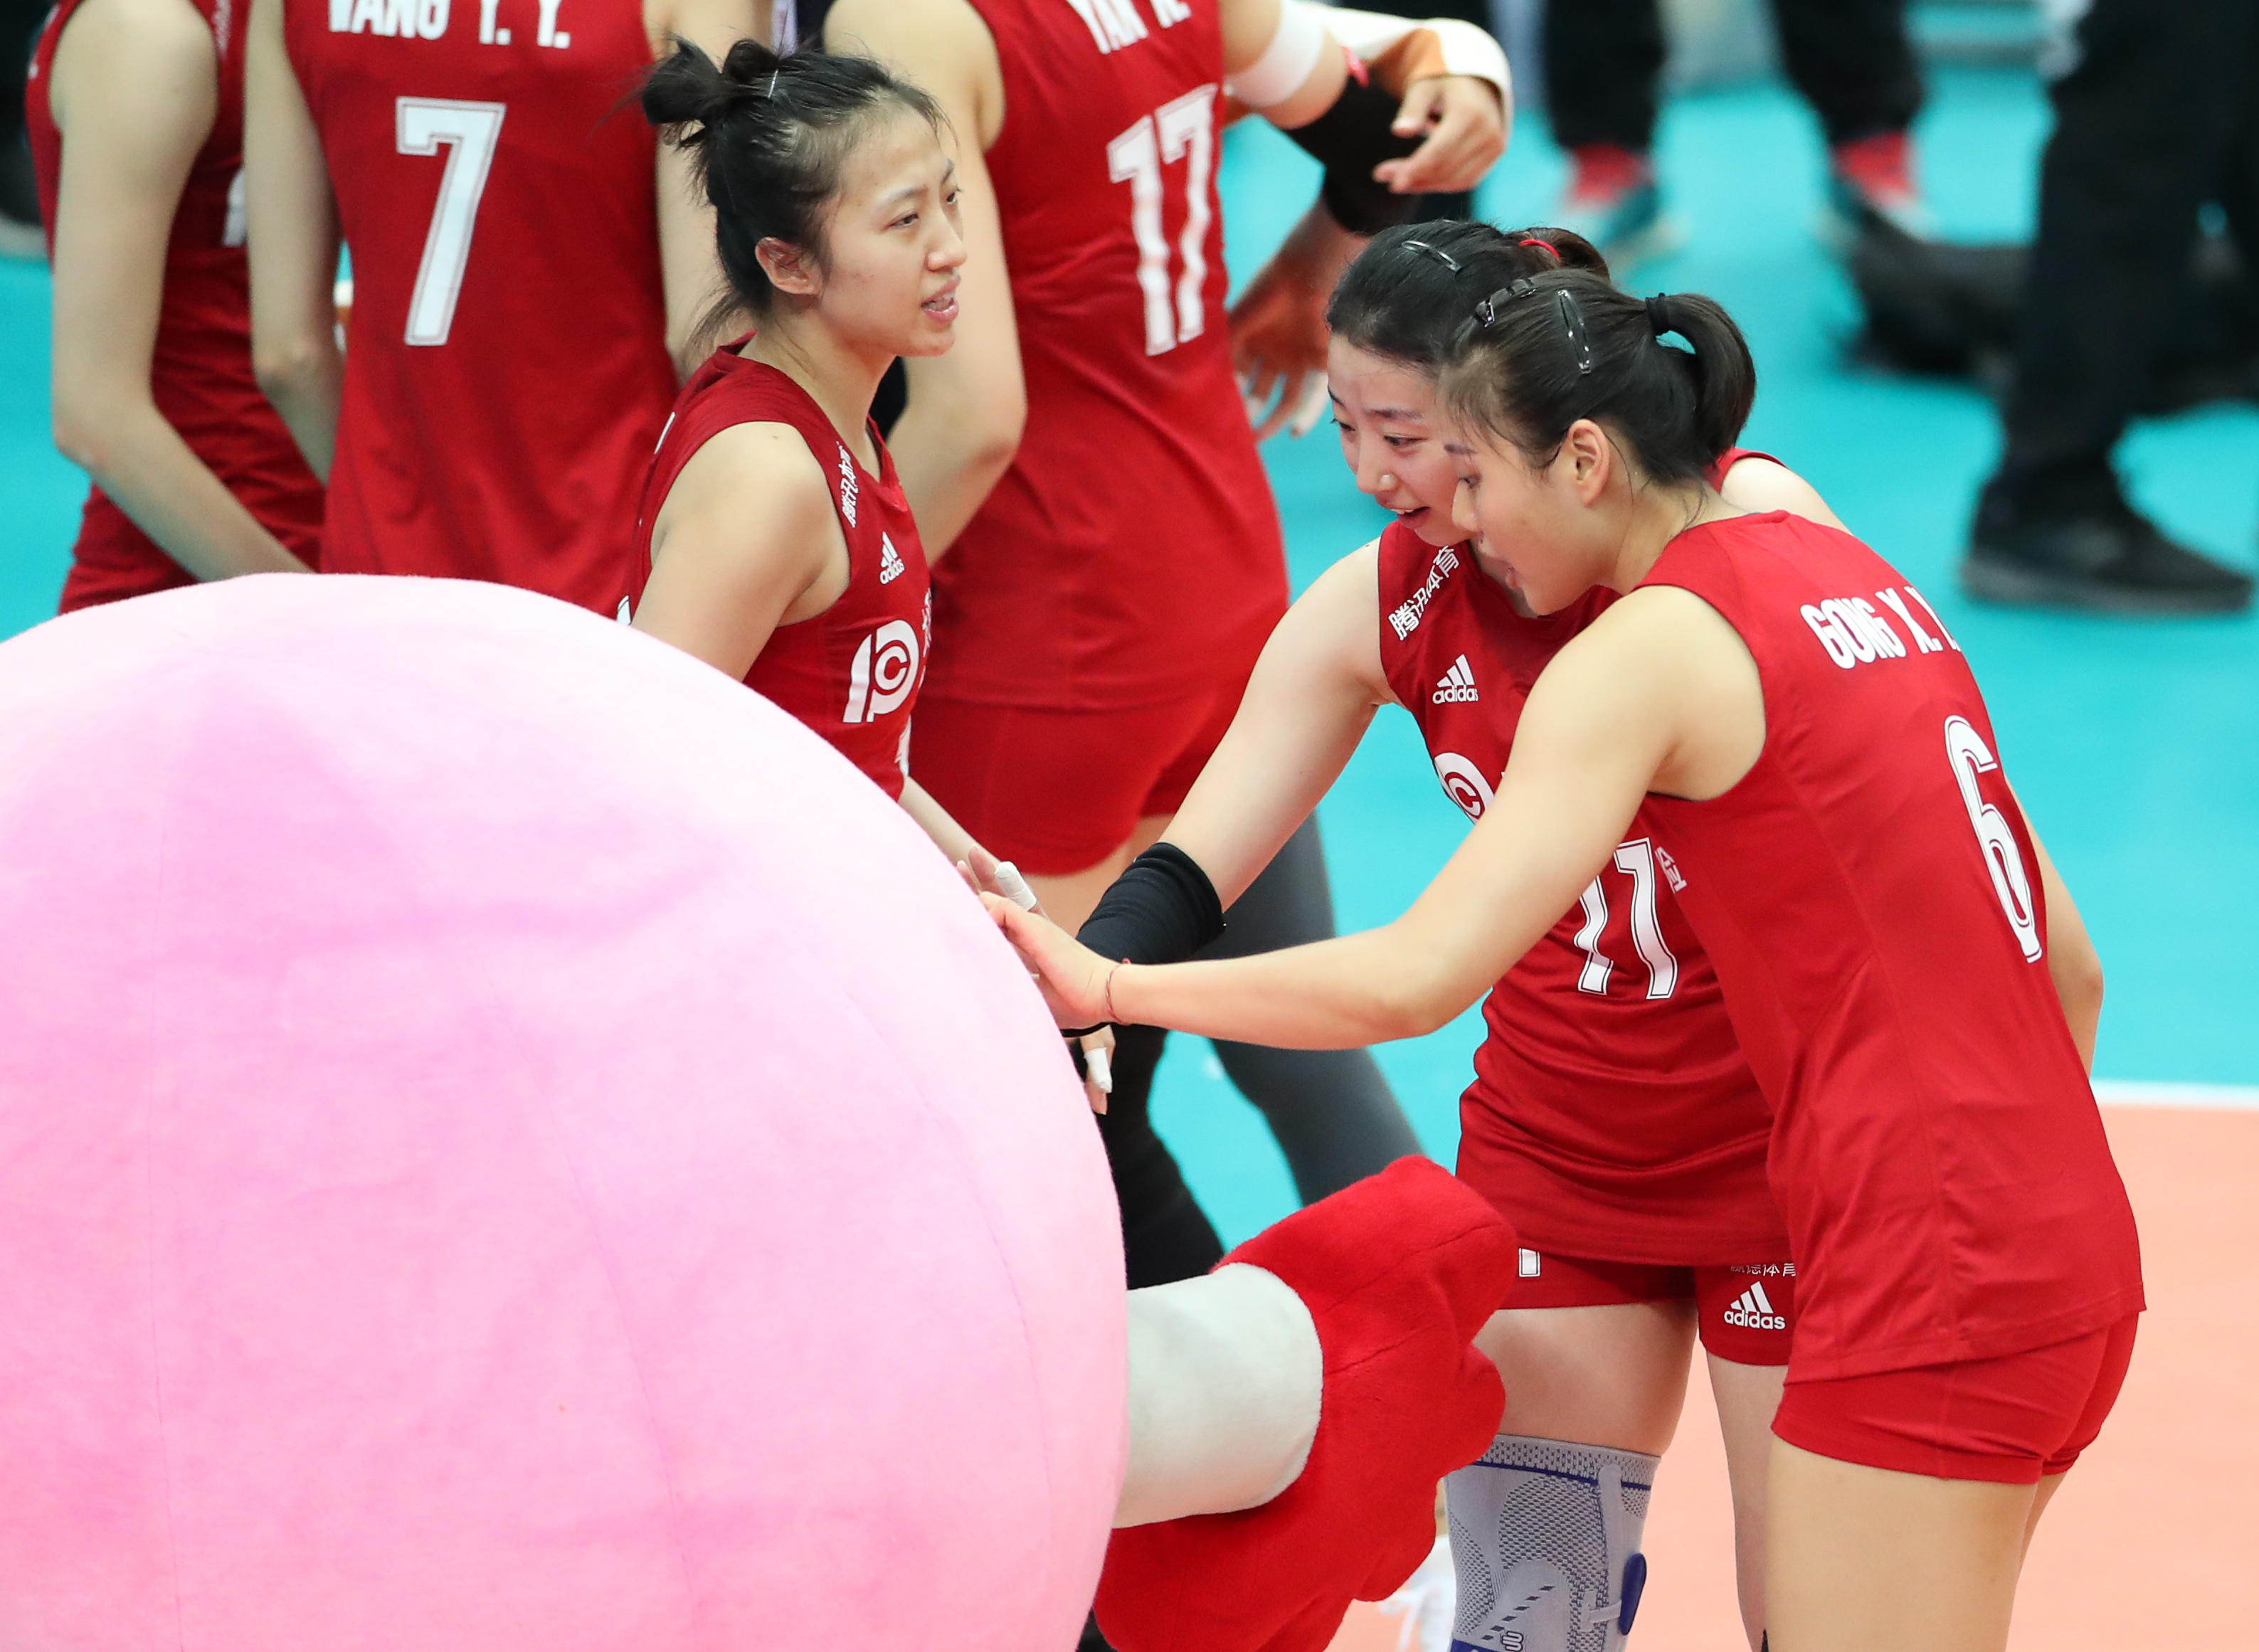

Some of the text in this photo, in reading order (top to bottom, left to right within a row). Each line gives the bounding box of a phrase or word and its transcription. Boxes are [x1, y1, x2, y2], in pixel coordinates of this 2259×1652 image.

[396, 97, 507, 346] 7
[1106, 83, 1218, 356] 17
[1387, 545, 1460, 641] 腾讯体育
[1799, 597, 1908, 669] GONG
[1432, 685, 1478, 704] adidas
[1944, 714, 2042, 963] 6
[1723, 1309, 1787, 1330] adidas
